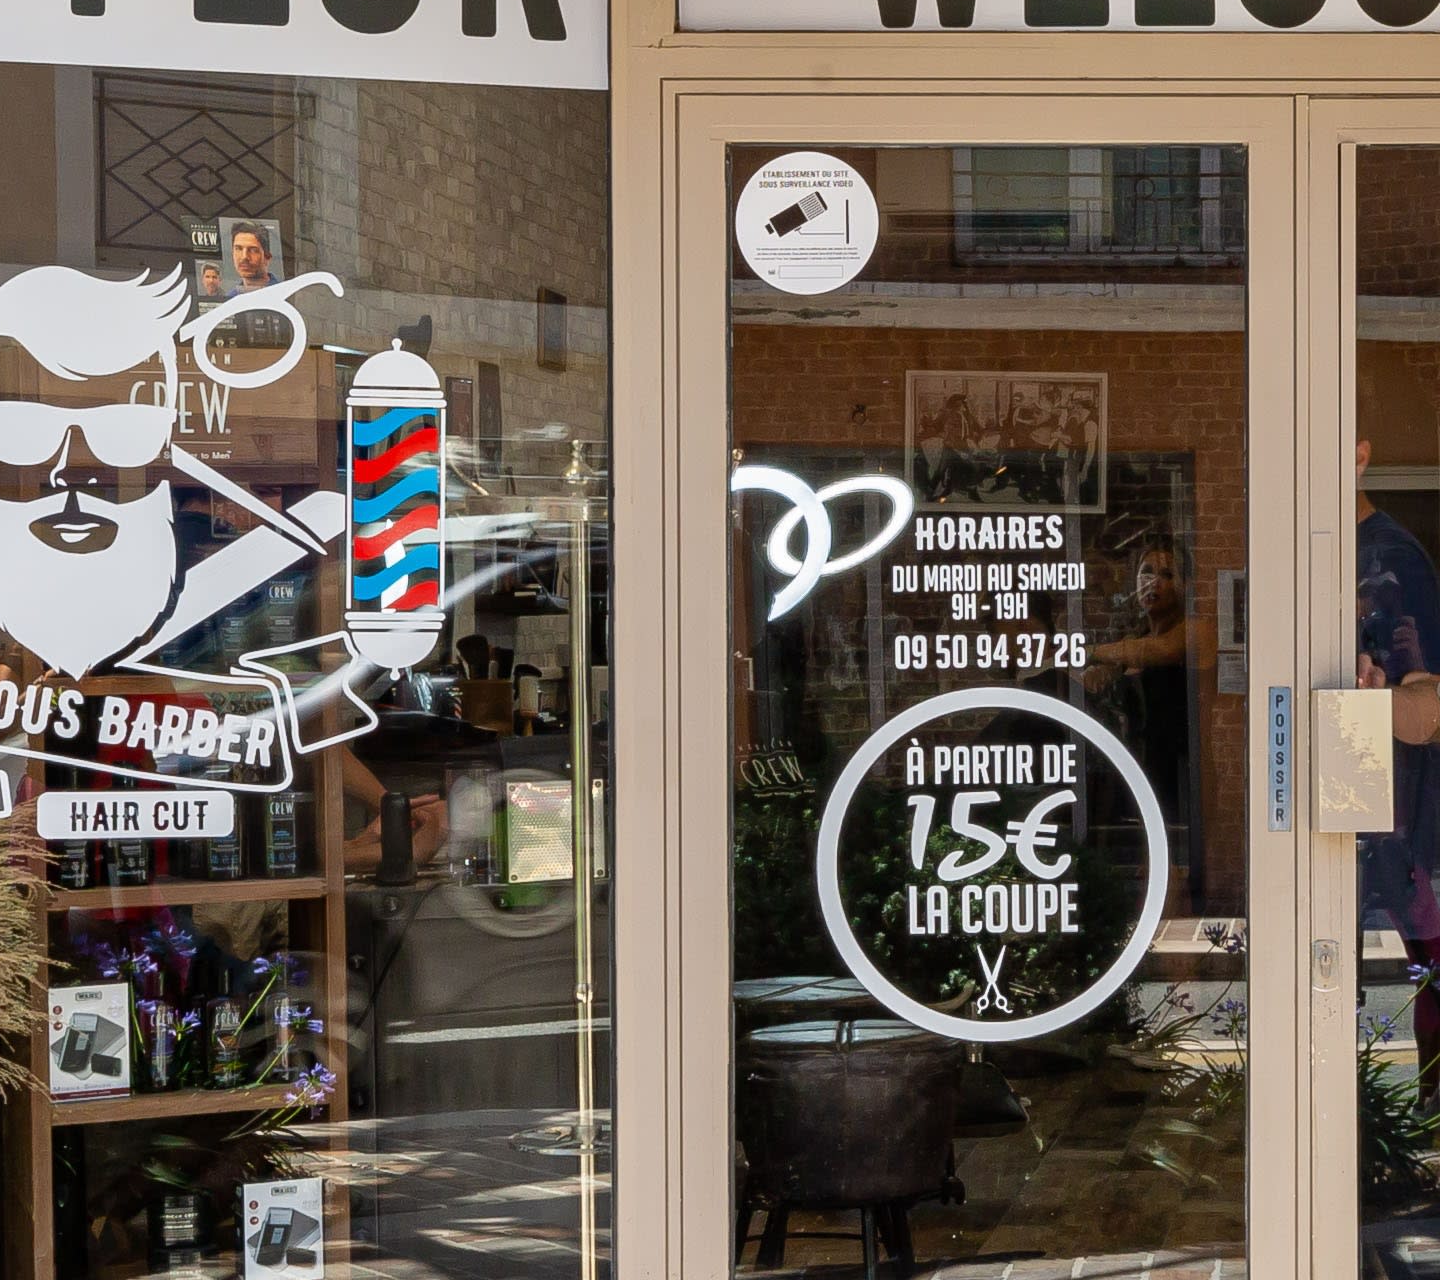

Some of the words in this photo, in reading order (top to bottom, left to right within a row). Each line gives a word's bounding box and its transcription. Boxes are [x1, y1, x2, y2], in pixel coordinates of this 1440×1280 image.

[759, 180, 777, 188] SOUS
[780, 180, 831, 188] SURVEILLANCE
[833, 170, 848, 178] SITE
[191, 231, 217, 246] CREW
[914, 515, 1063, 551] HORAIRES
[269, 585, 295, 599] CREW
[892, 565, 918, 593] DU
[923, 564, 982, 592] MARDI
[987, 564, 1012, 591] AU
[1018, 563, 1086, 590] SAMEDI
[951, 593, 977, 620] 9H
[994, 593, 1029, 620] 19H
[894, 634, 928, 669] 09
[935, 634, 968, 669] 50
[976, 634, 1010, 669] 94
[1016, 633, 1046, 668] 37
[1053, 632, 1086, 668] 26
[97, 694, 277, 769] BARBER
[740, 755, 804, 788] CREW
[906, 739, 925, 785] À
[934, 744, 1033, 785] PARTIR
[1043, 743, 1077, 784] DE
[1275, 694, 1285, 822] POUSSER
[70, 801, 140, 832] HAIR
[152, 800, 209, 831] CUT
[269, 801, 295, 815] CREW
[907, 789, 1077, 882] 15€
[909, 884, 949, 935] LA
[961, 883, 1079, 935] COUPE
